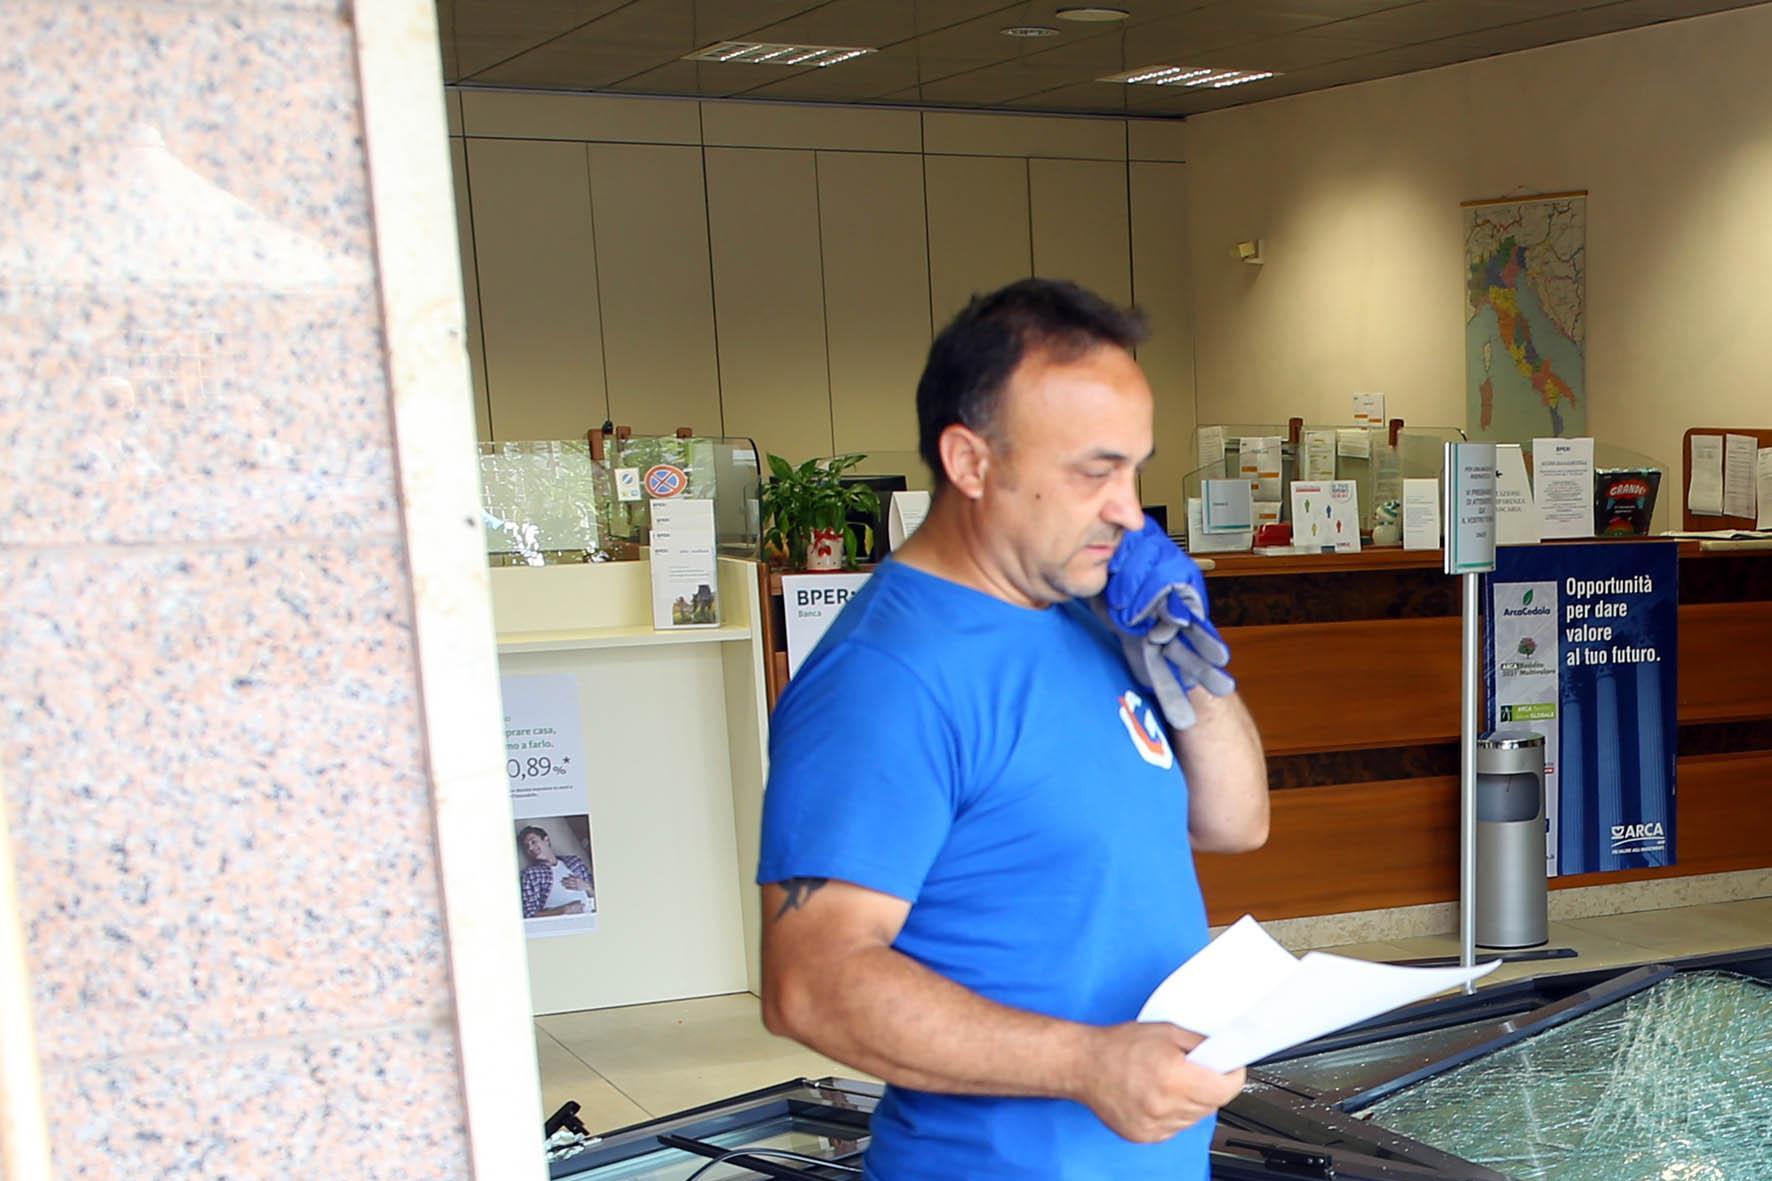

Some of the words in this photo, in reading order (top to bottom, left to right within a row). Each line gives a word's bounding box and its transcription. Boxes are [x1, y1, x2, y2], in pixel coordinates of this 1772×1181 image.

[1566, 575, 1652, 599] Opportunità
[1503, 607, 1551, 616] ArcaCedola
[1566, 605, 1591, 623] per
[1594, 600, 1628, 618] dare
[1566, 624, 1613, 643] valore
[1566, 648, 1580, 666] al
[1584, 648, 1607, 665] tuo
[1612, 646, 1661, 664] futuro.
[505, 728, 531, 739] prare
[532, 727, 557, 736] casa,
[528, 740, 554, 749] farlo.
[1624, 822, 1664, 838] ARCA
